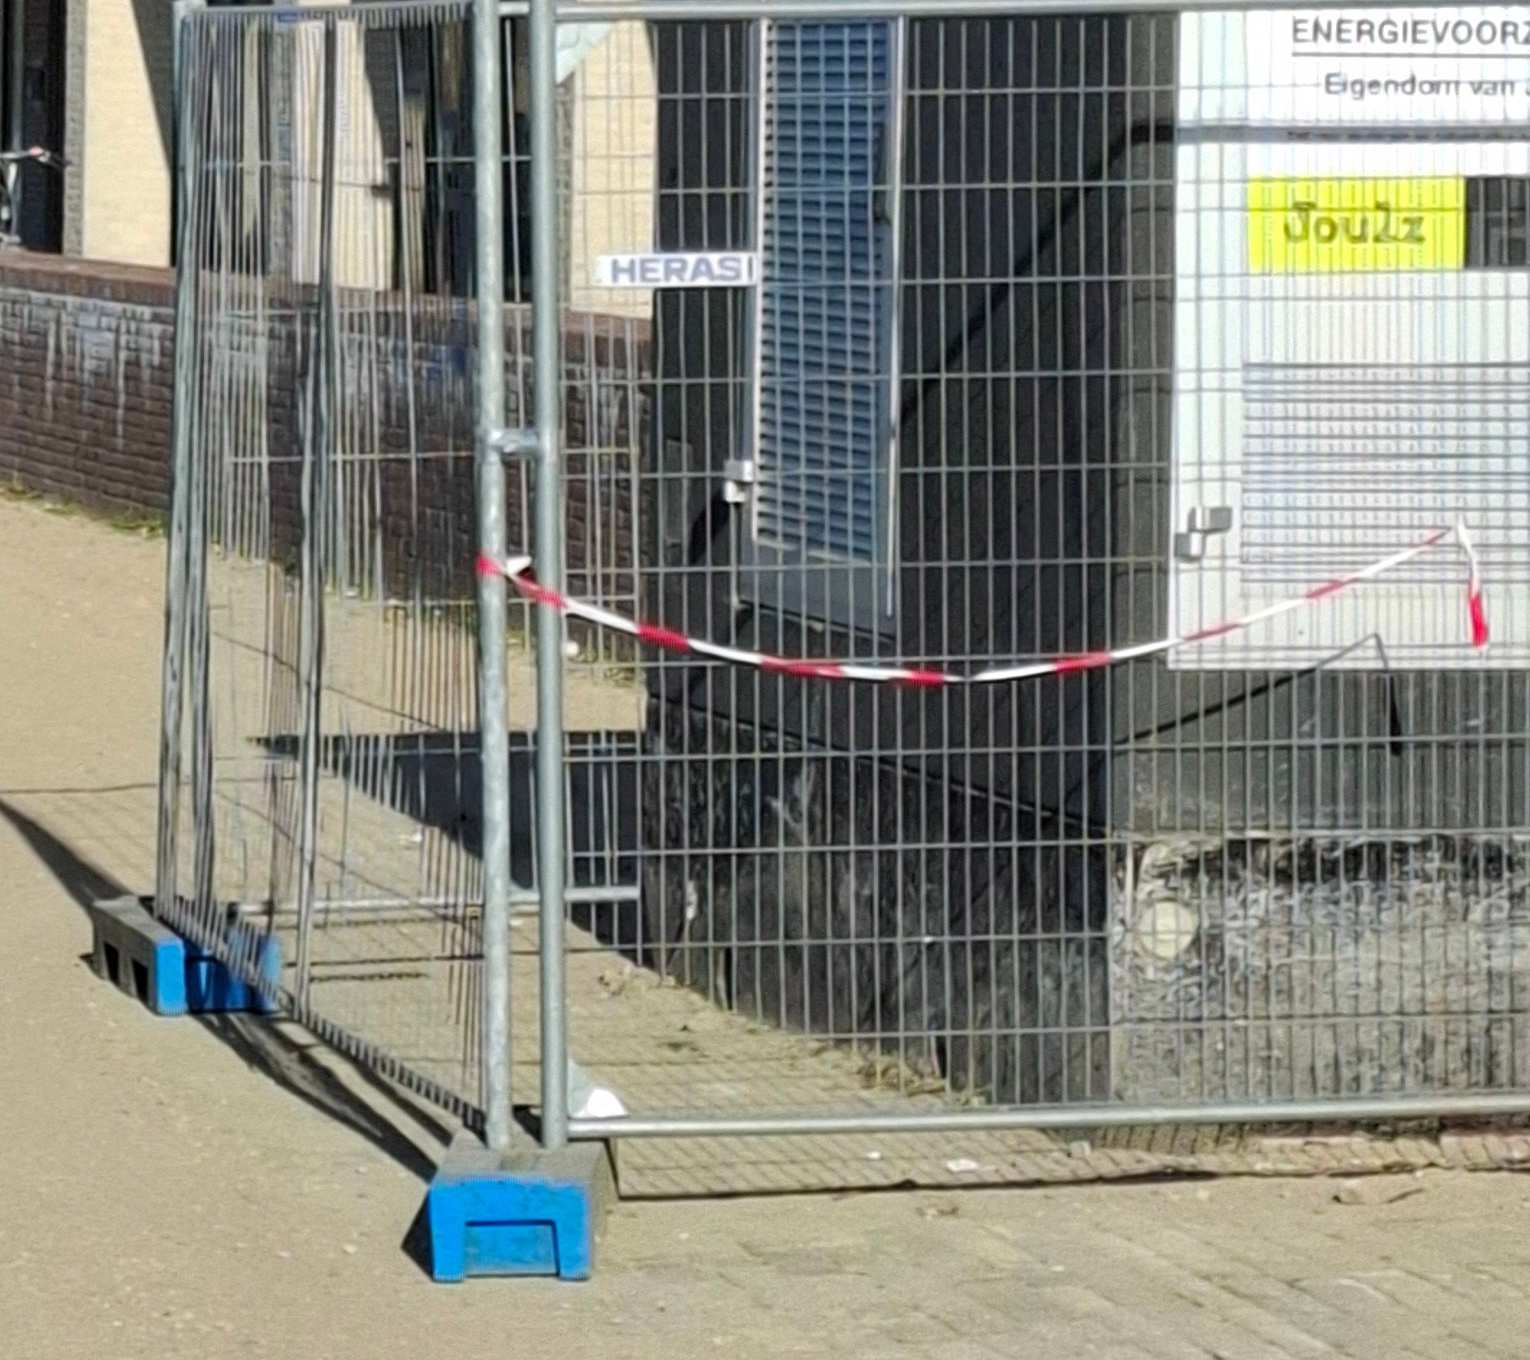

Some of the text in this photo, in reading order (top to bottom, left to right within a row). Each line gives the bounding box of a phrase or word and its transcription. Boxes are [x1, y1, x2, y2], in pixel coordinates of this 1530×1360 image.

[1324, 72, 1515, 100] Eigendom van
[1283, 200, 1426, 244] Joulz
